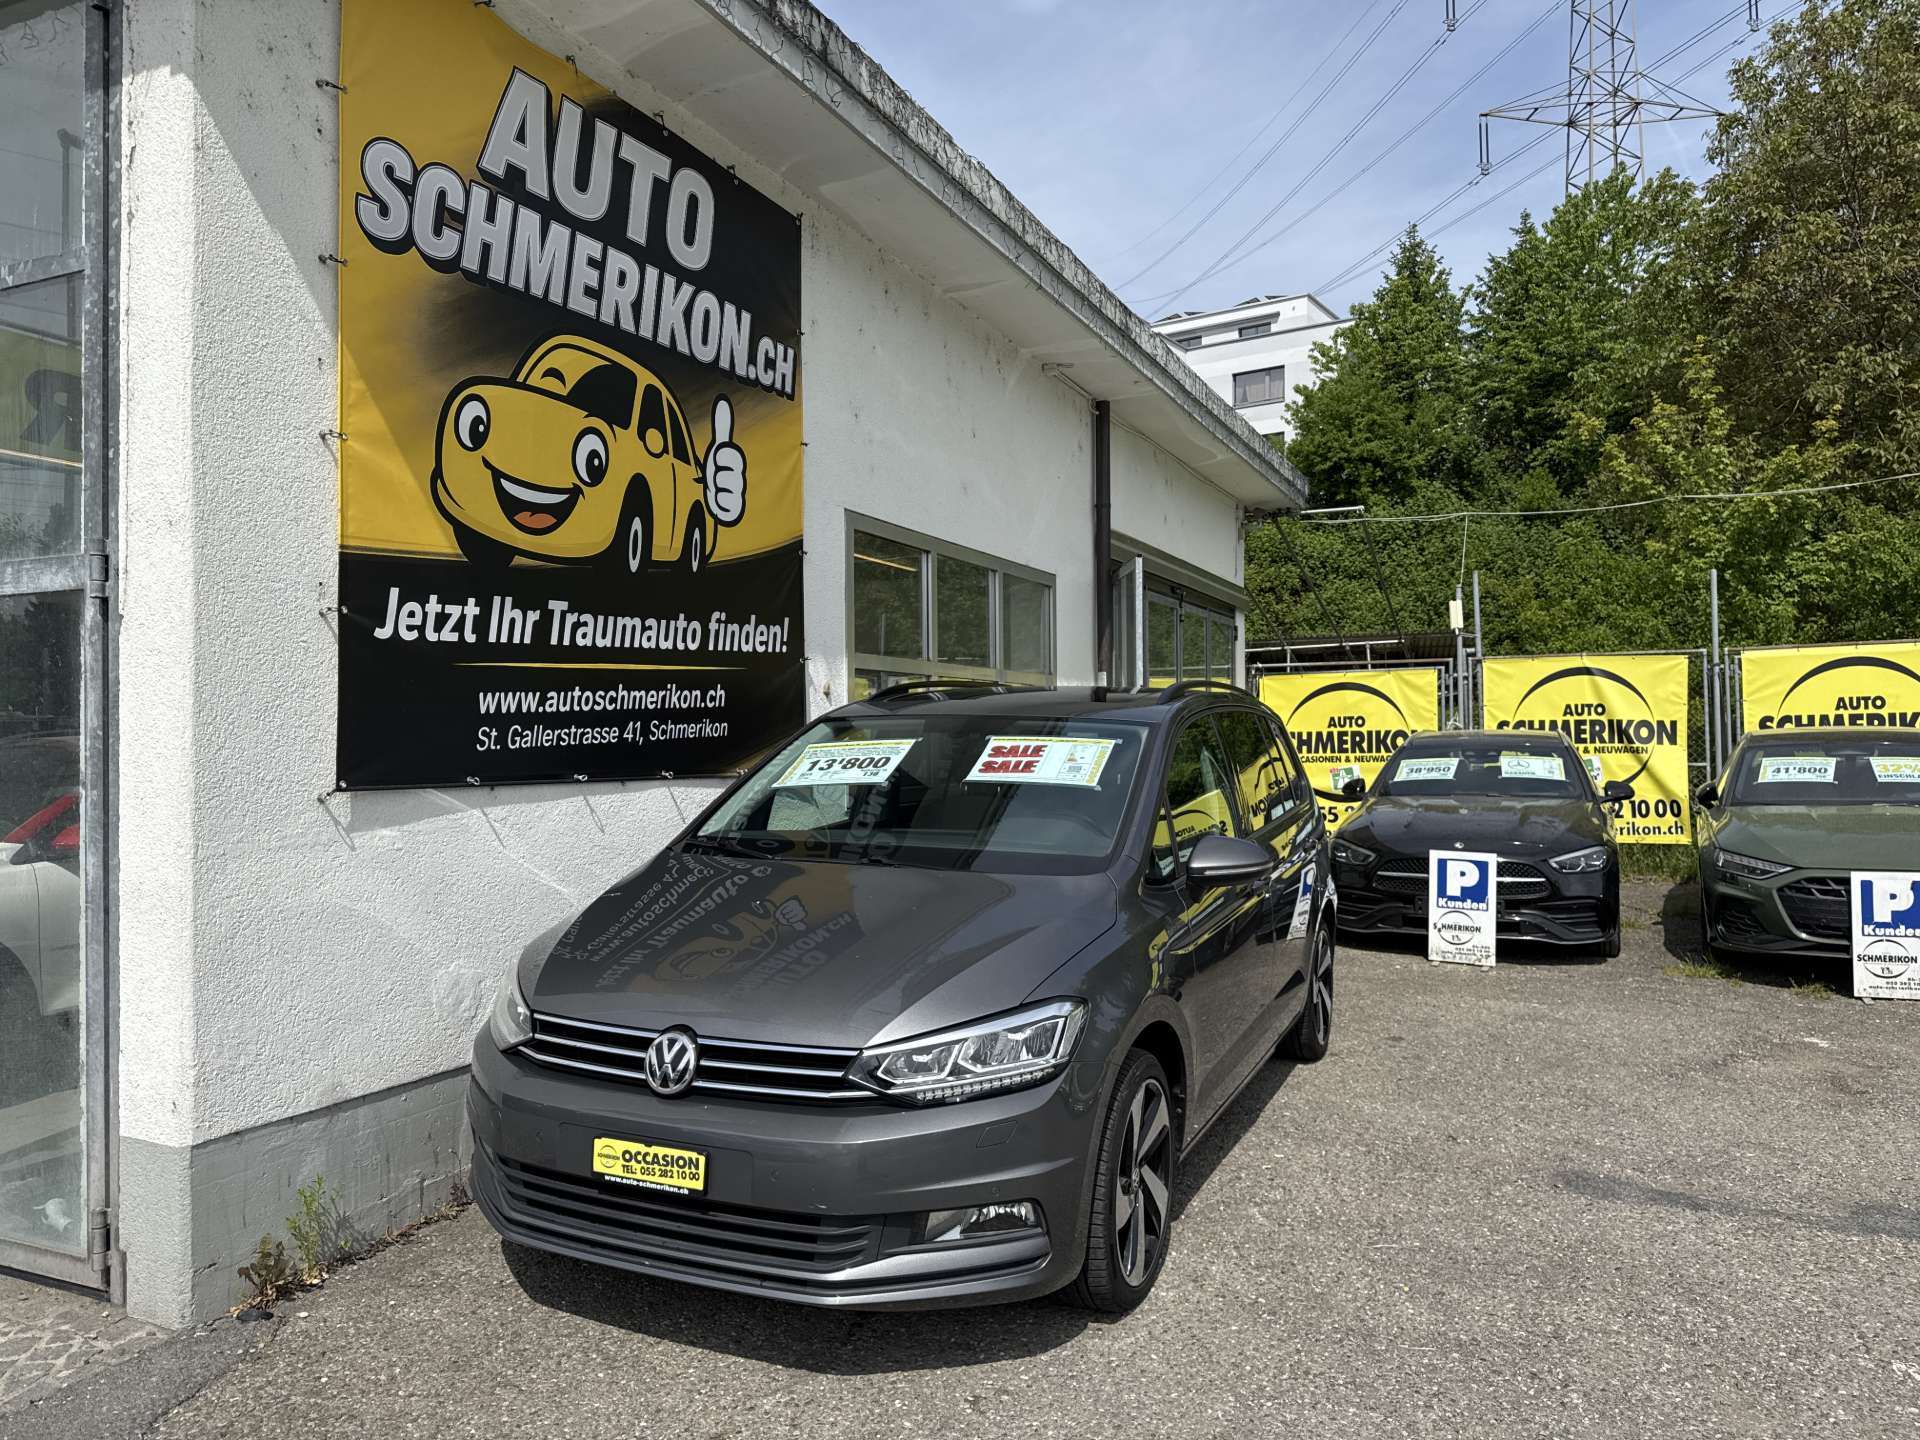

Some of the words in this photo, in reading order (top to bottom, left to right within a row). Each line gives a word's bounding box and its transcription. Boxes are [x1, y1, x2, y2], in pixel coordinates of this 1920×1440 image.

[478, 67, 714, 271] AUTO
[356, 138, 795, 396] SCHMERIKON.CH
[373, 587, 480, 642] Jetzt
[488, 596, 539, 644] Ihr
[548, 600, 701, 651] Traumauto
[707, 610, 789, 653] finden!
[478, 684, 725, 714] www.autoschmerikon.ch
[1835, 695, 1887, 711] AUTO
[1563, 703, 1606, 717] AUTO
[1327, 716, 1366, 728] AUTO
[476, 726, 501, 752] St.
[508, 721, 618, 748] Gallerstrasse
[623, 721, 644, 746] 41,
[649, 719, 728, 741] Schmerikon
[988, 744, 1048, 758] SALE
[1583, 746, 1590, 754] &
[1594, 746, 1648, 755] NEUWAGEN
[807, 756, 892, 772] 13'800
[978, 760, 1040, 773] SALE
[1771, 766, 1829, 774] 41'800
[1629, 799, 1650, 819] 10
[1654, 799, 1682, 818] 00
[1446, 860, 1480, 897] P
[1437, 897, 1488, 911] Kunden
[1872, 880, 1914, 922] P
[1433, 922, 1481, 934] SHMERIKON
[1857, 954, 1917, 964] SCHMERIKON
[621, 1150, 700, 1171] OCCASION
[622, 1165, 637, 1174] TEL:
[640, 1167, 656, 1176] 055
[658, 1168, 674, 1179] 282
[677, 1170, 687, 1180] 10
[688, 1172, 700, 1181] 00
[605, 1175, 689, 1195] www.auto-schmerikon.ch
